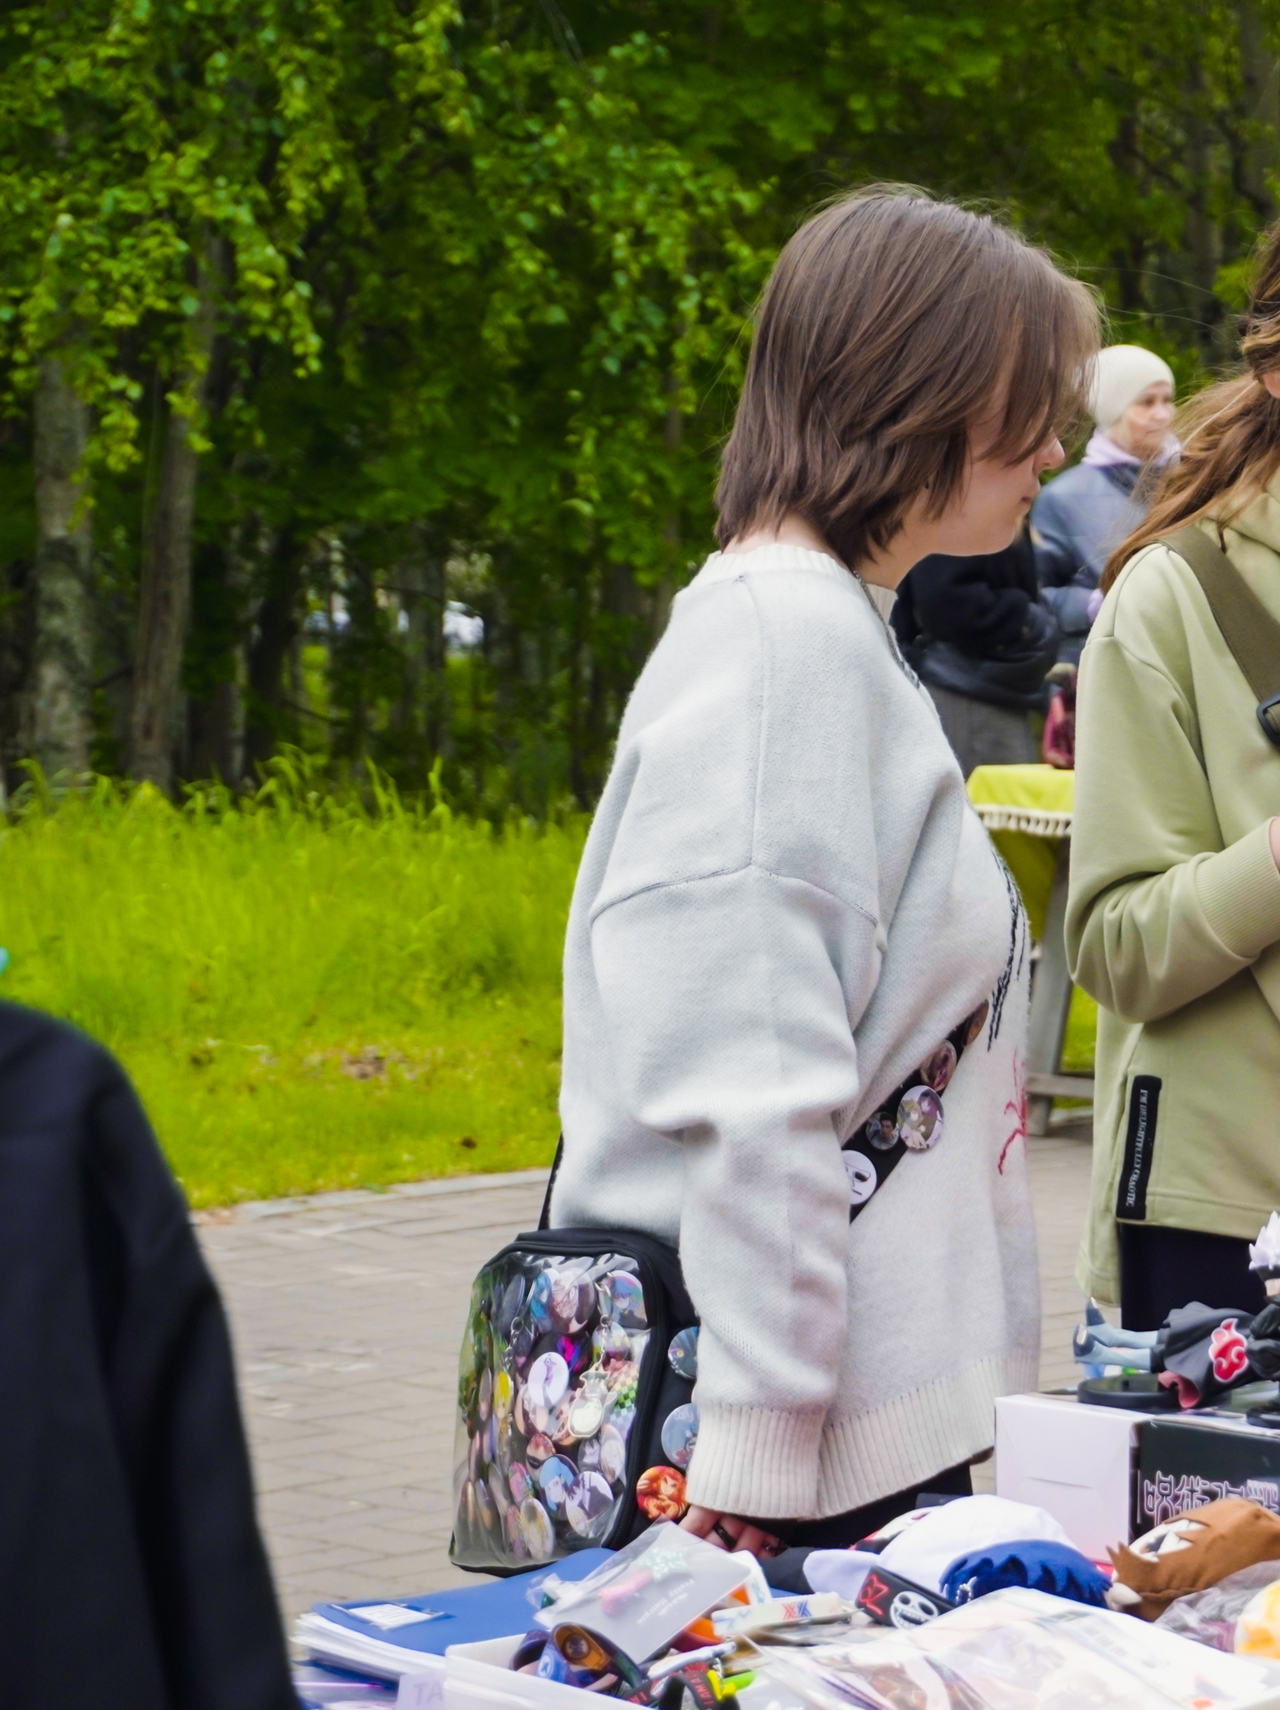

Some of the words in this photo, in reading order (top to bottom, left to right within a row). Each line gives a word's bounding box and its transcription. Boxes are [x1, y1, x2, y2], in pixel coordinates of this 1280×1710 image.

[1139, 1088, 1148, 1104] I'M
[1133, 1104, 1148, 1169] DELIGHTFULLY
[1125, 1169, 1141, 1207] CHAOTIC
[668, 1578, 695, 1598] Pretty
[636, 1597, 668, 1625] Hairpin
